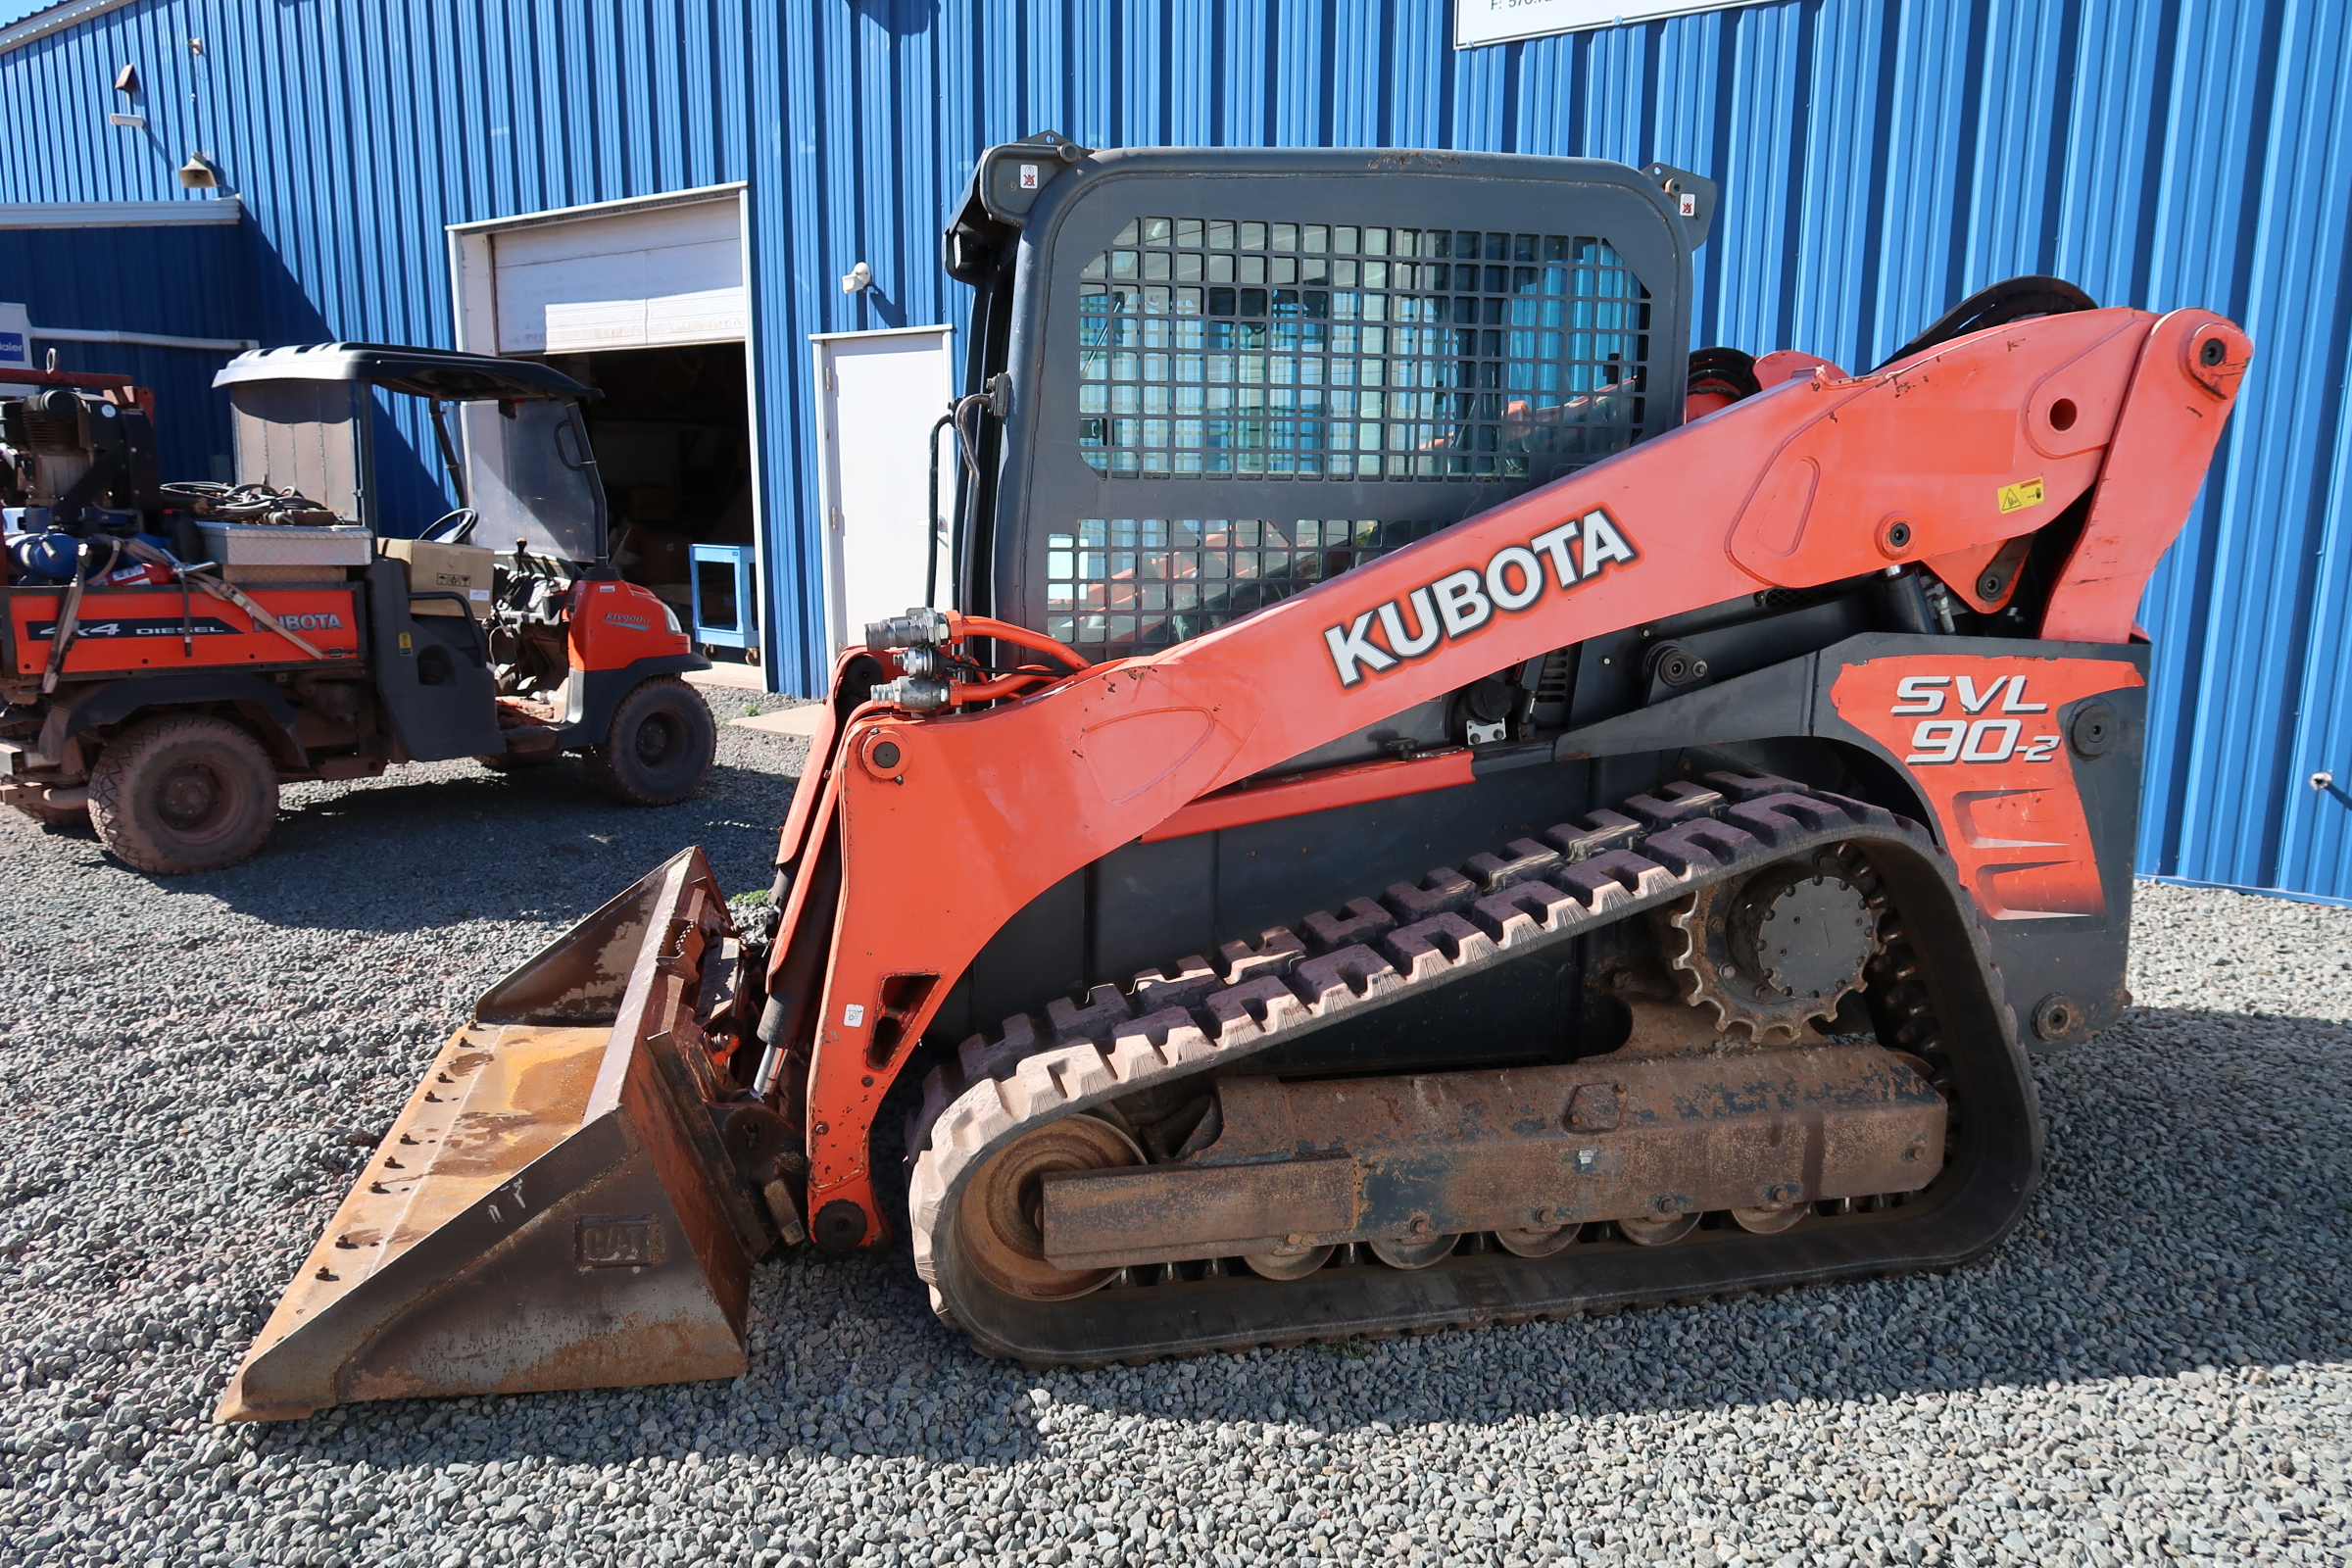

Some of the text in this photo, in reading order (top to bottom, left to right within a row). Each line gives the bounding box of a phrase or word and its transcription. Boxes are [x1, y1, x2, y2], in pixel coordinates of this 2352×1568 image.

[0, 342, 23, 352] aier
[1324, 510, 1635, 687] KUBOTA
[136, 626, 224, 635] DIESEL
[1889, 675, 2049, 715] SVL
[1905, 718, 2061, 764] 90-2
[583, 1226, 648, 1261] CAT
